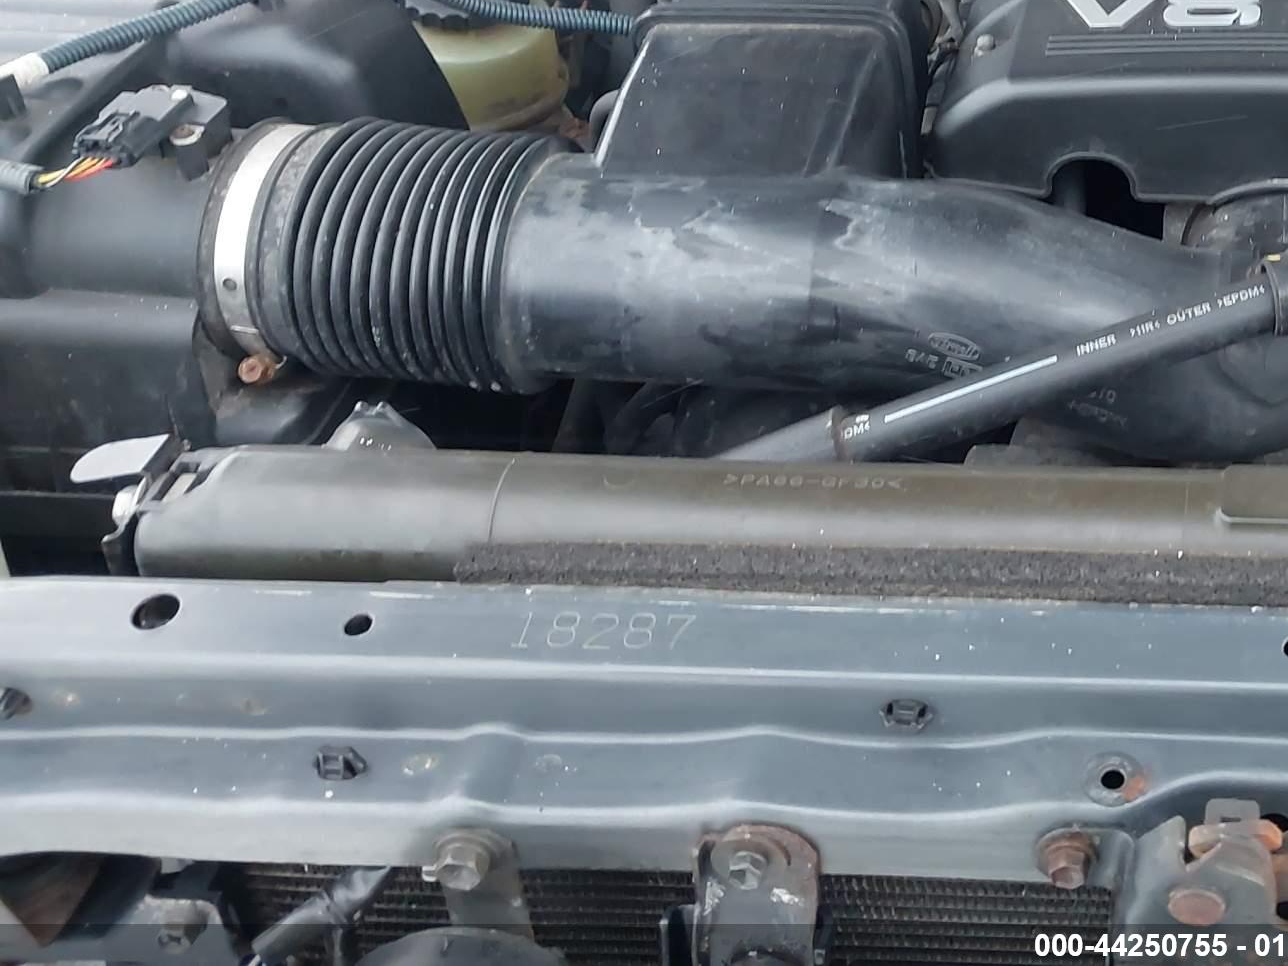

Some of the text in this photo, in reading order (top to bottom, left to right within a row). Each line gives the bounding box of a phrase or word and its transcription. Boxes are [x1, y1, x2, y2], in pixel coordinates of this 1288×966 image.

[1076, 333, 1117, 357] INNER
[1166, 301, 1212, 326] OUTER
[511, 610, 697, 651] 18287
